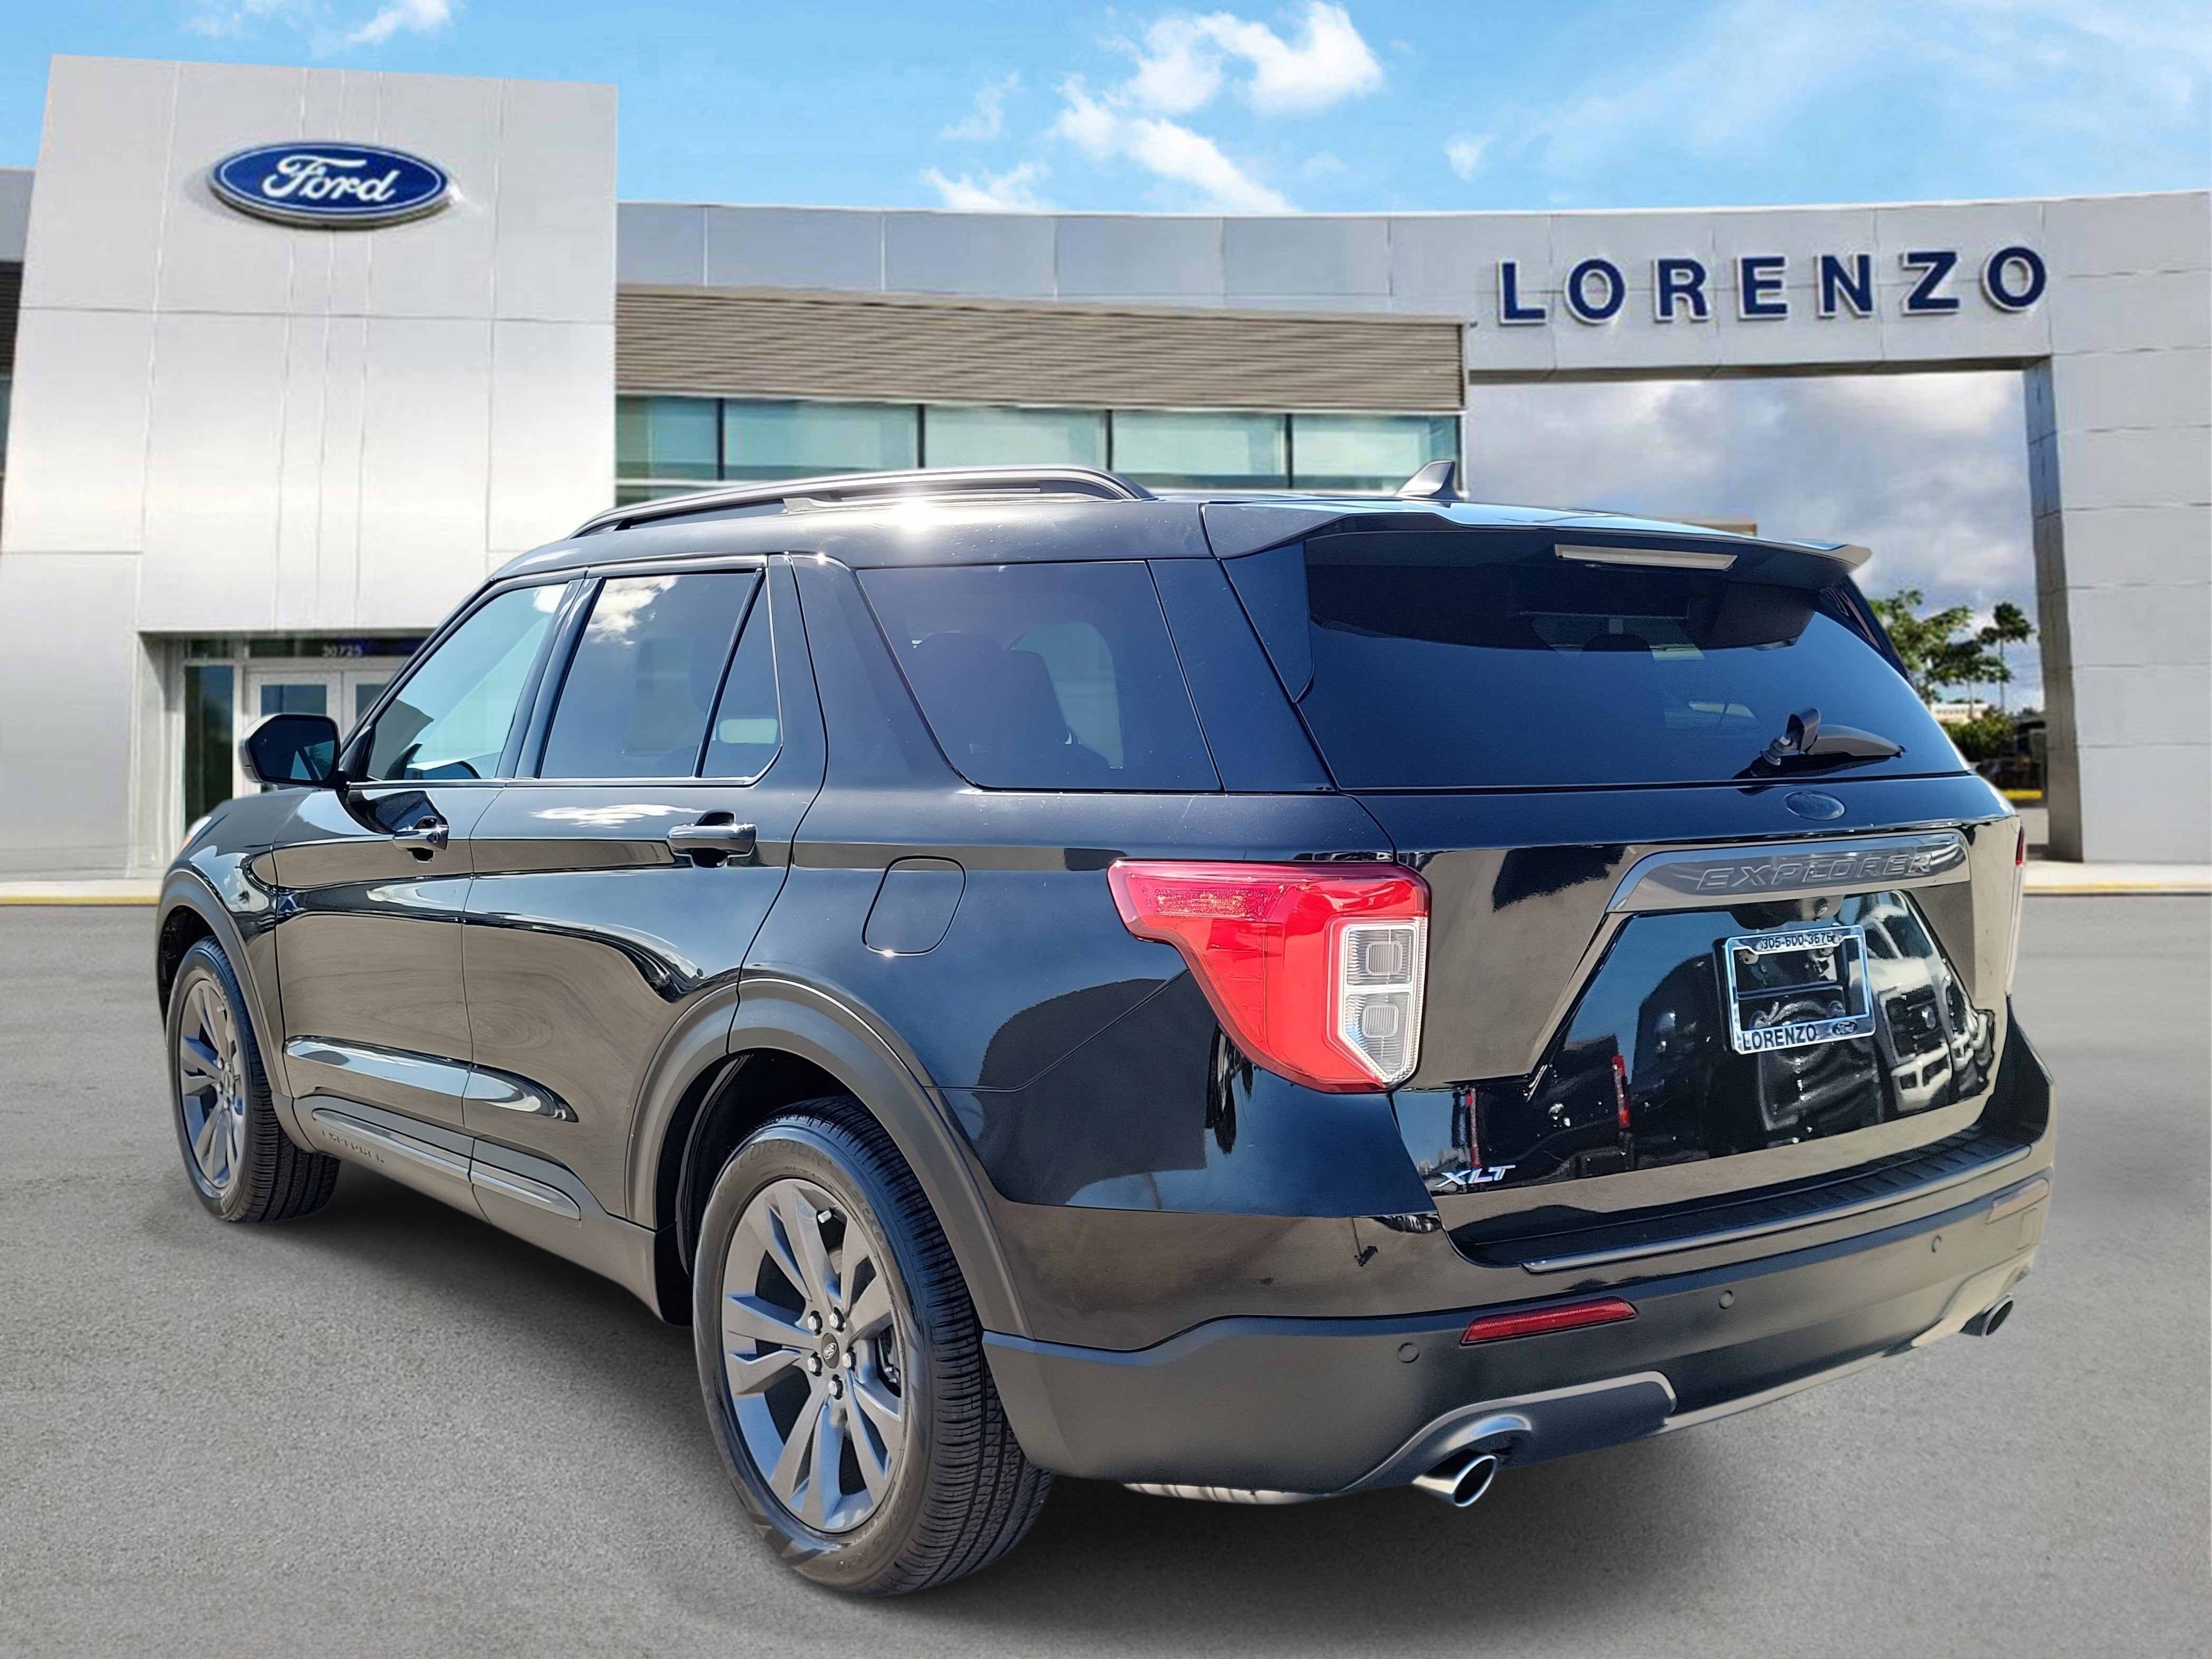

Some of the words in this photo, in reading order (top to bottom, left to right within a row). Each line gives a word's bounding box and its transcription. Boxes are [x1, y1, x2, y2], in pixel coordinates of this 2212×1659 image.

[262, 155, 400, 202] Ford
[1498, 246, 2046, 324] LORENZO
[1697, 853, 1932, 890] EXPLORER
[1741, 1024, 1816, 1051] LORENZO
[1434, 1165, 1516, 1187] XLT
